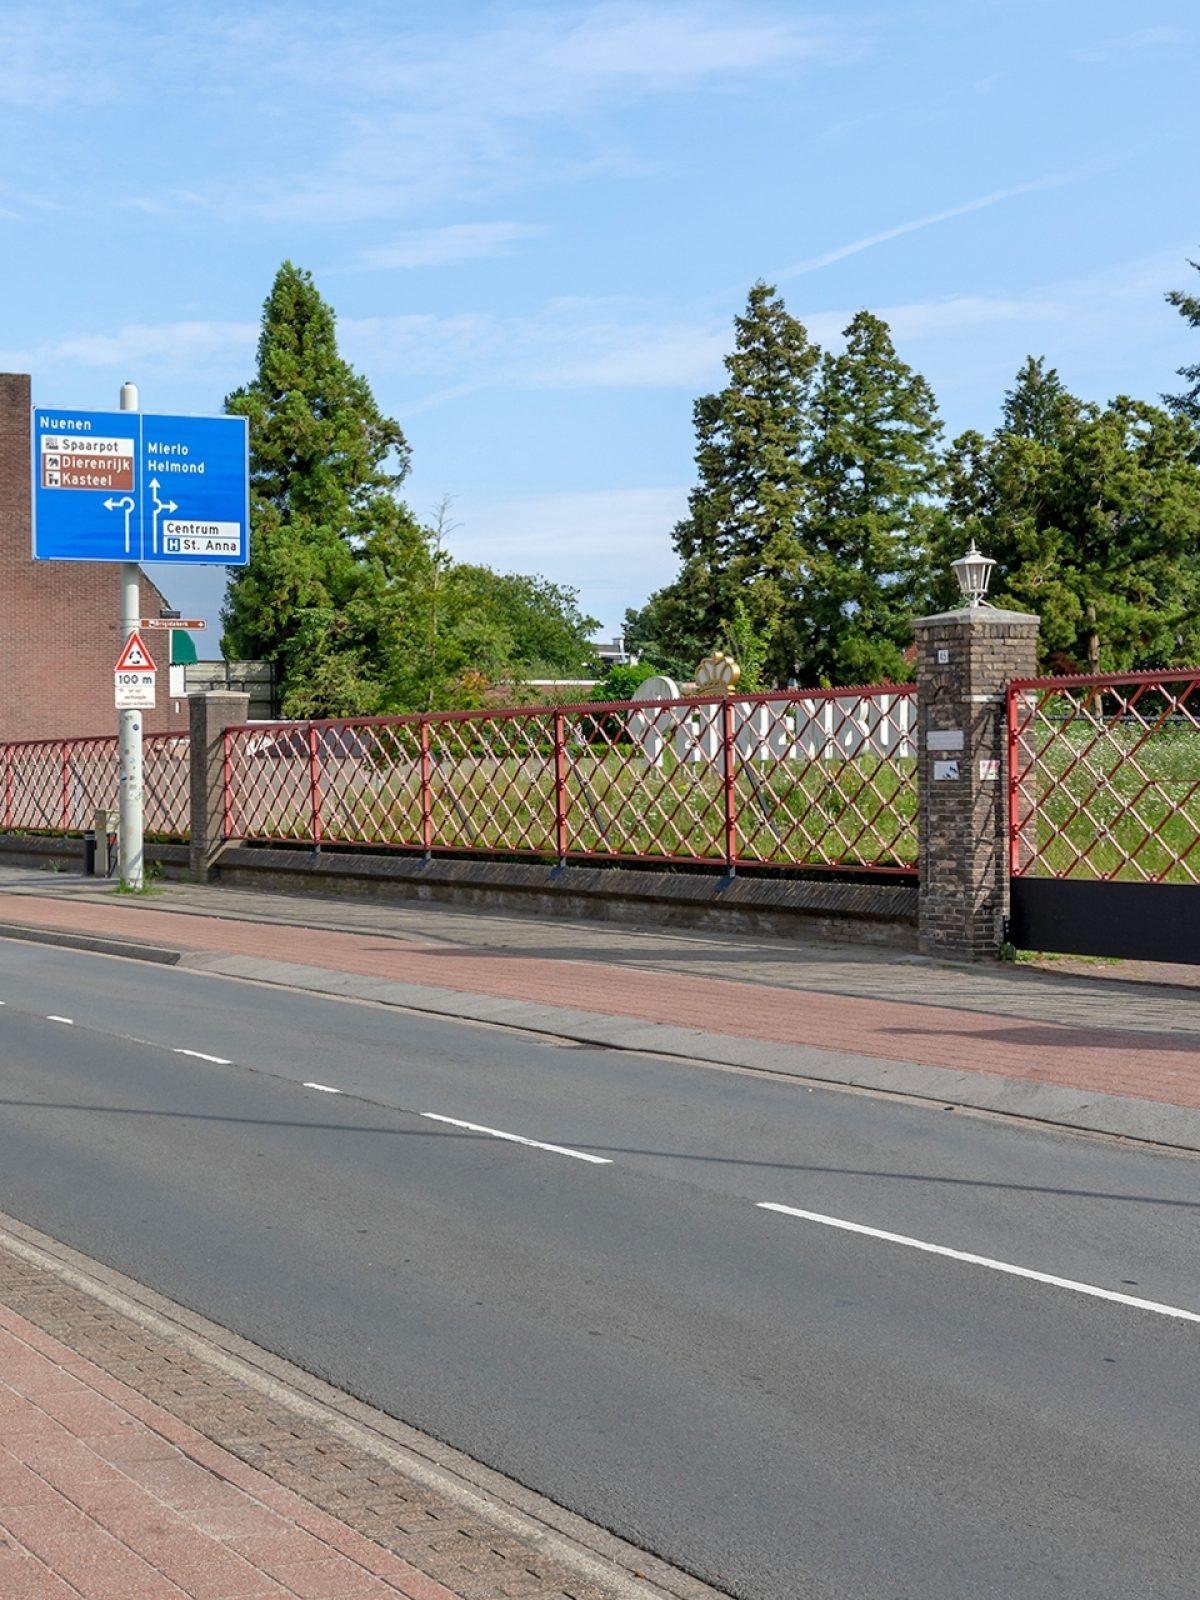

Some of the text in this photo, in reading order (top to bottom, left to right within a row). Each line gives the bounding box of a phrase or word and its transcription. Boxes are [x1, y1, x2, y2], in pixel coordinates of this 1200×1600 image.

[40, 416, 91, 430] Nuenen
[62, 438, 119, 453] Spaarpot
[147, 441, 189, 456] Mierlo
[62, 455, 130, 474] Dierenrijk
[147, 459, 205, 474] Helmond
[62, 472, 112, 486] Kasteel
[166, 522, 220, 535] Centrum
[183, 539, 200, 550] St.
[205, 540, 237, 552] Anna
[118, 674, 152, 685] 100 m
